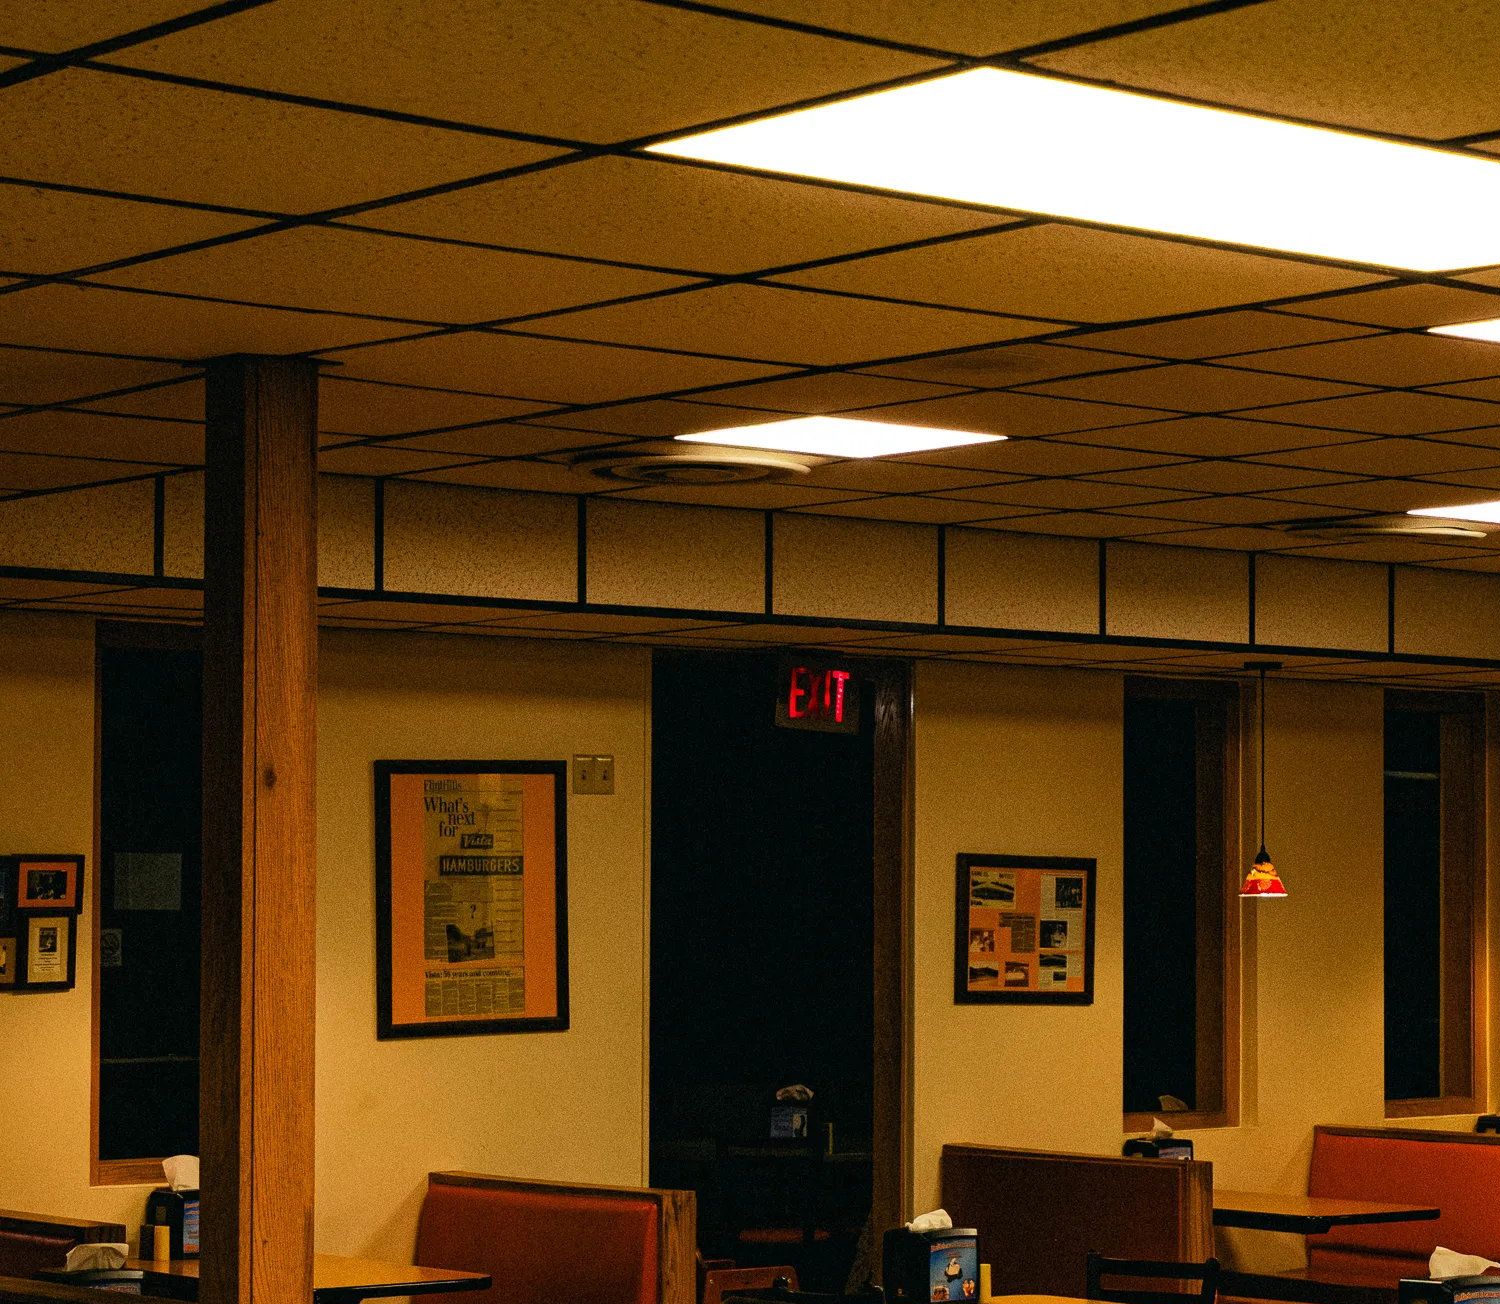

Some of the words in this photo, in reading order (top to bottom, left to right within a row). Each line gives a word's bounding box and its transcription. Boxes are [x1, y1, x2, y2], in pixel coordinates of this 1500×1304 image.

[789, 667, 850, 723] EXIT
[424, 796, 469, 813] What's
[448, 811, 476, 826] next
[439, 821, 459, 837] for
[442, 857, 520, 873] HAMBURGERS
